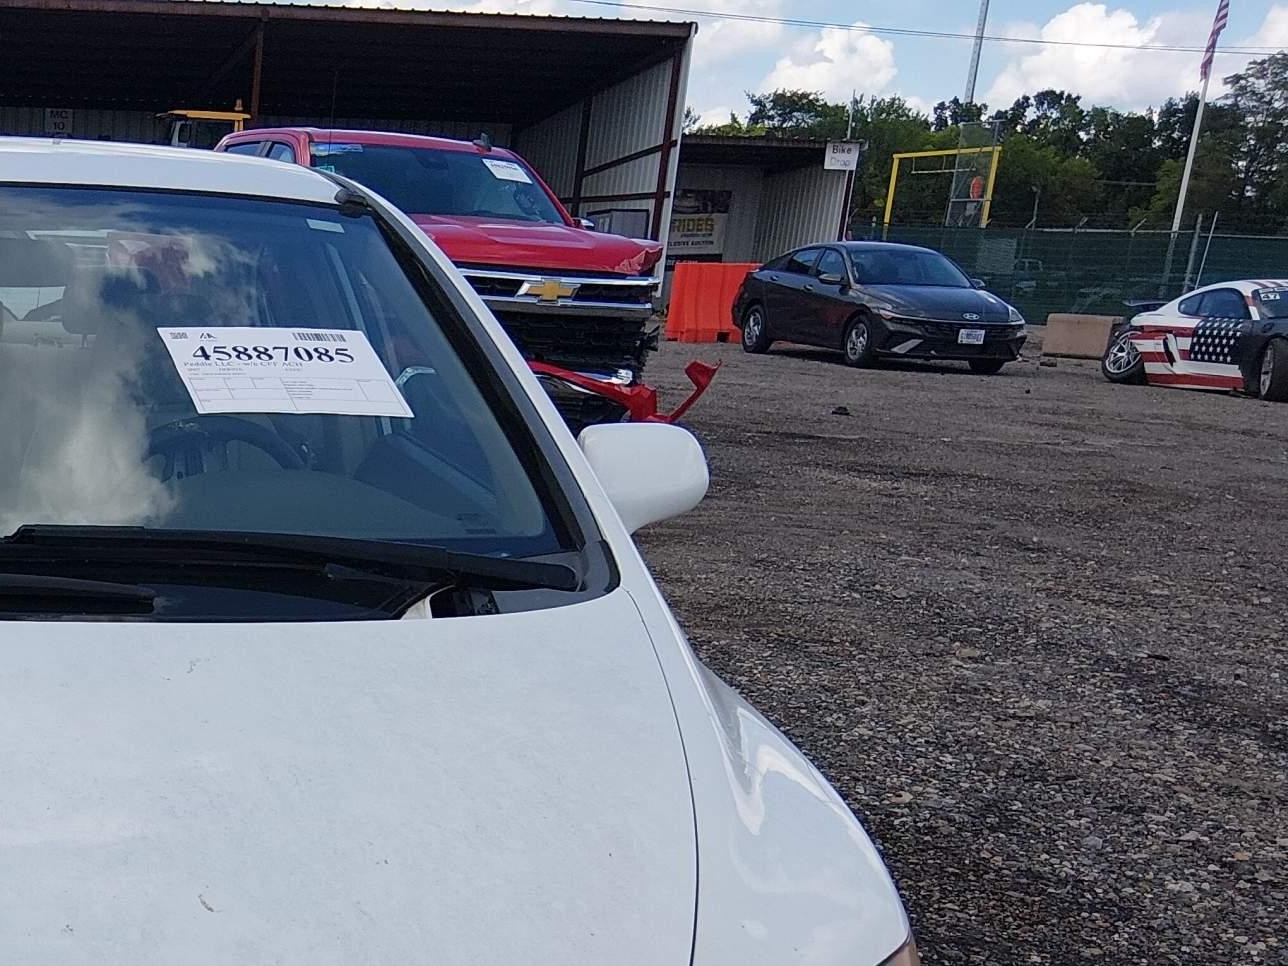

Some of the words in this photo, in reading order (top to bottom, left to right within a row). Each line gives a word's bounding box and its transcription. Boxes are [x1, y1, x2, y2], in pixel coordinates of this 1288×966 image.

[50, 110, 69, 119] MC
[53, 121, 65, 130] 10
[832, 144, 852, 154] Bike
[192, 345, 355, 363] 45887085
